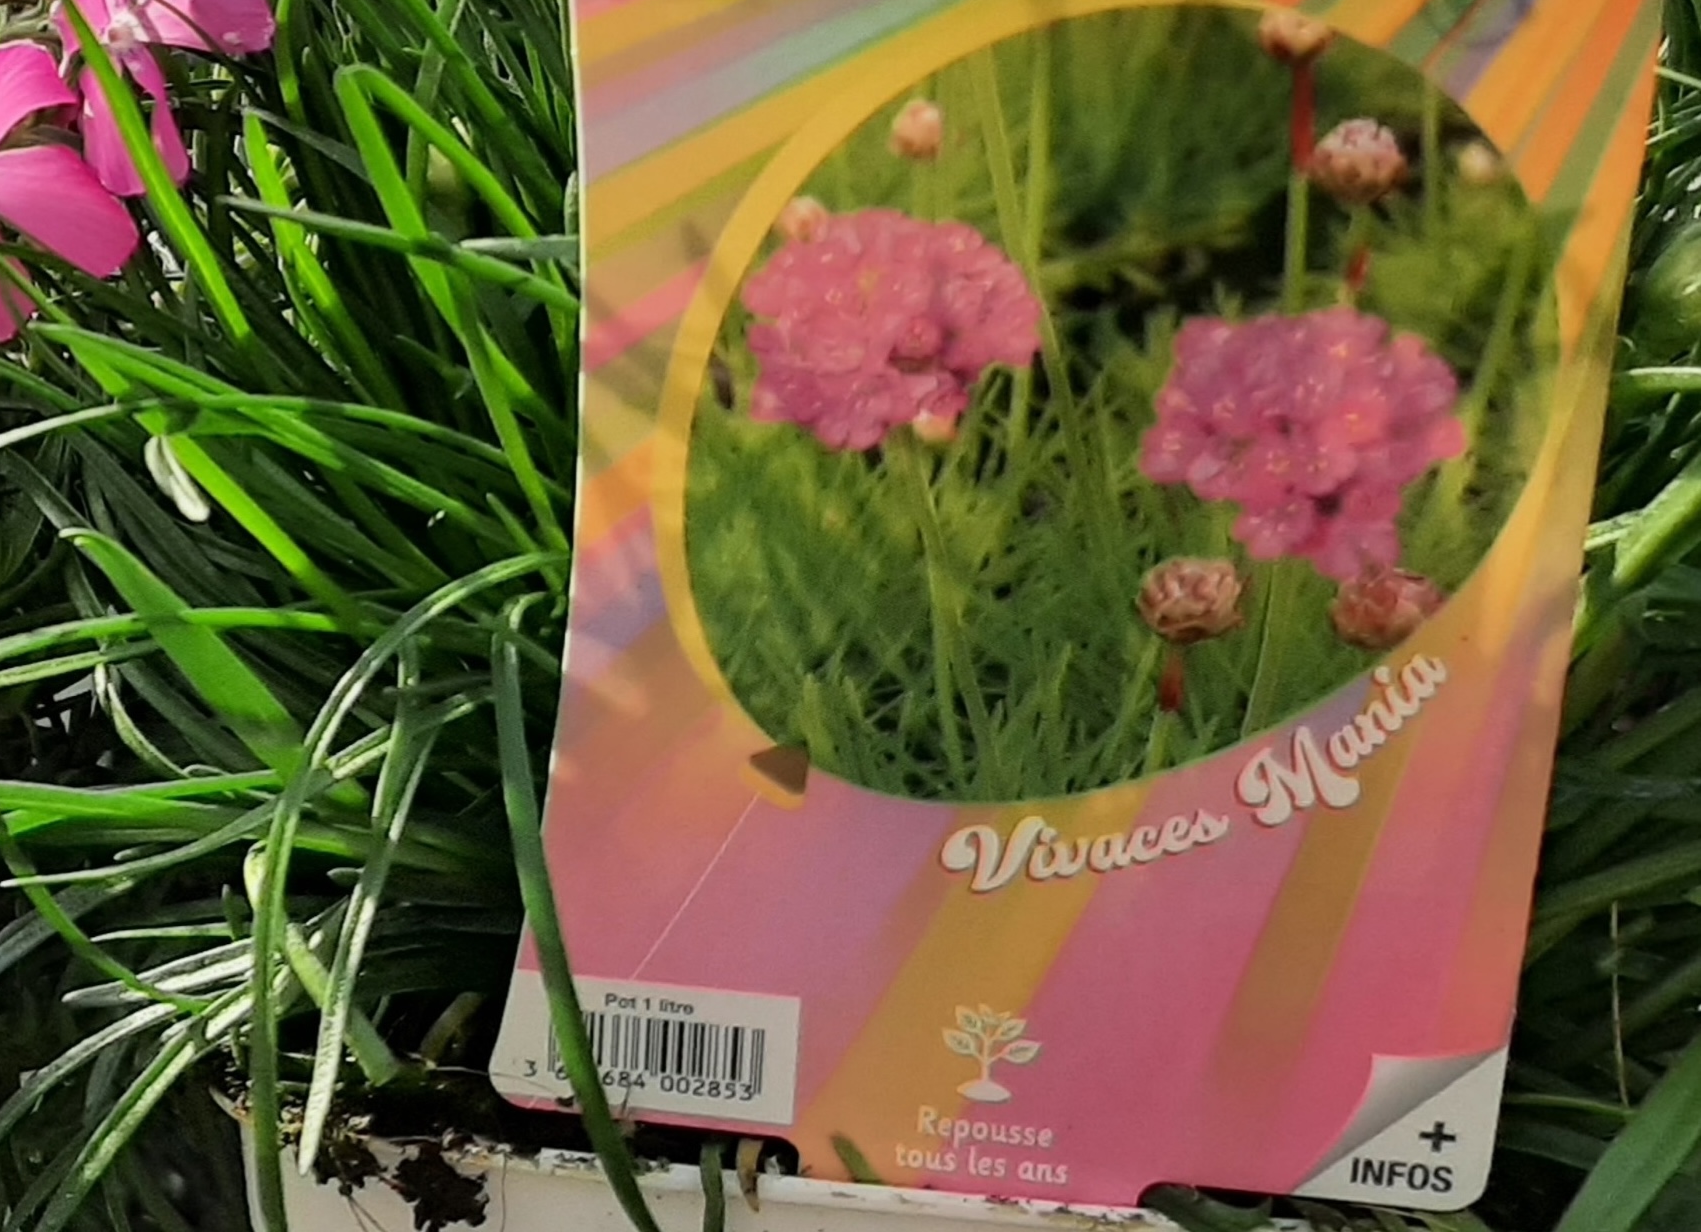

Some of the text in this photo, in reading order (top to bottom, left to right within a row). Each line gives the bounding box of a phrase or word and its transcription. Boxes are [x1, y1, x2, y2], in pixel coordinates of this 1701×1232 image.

[940, 654, 1447, 893] Vivaces Mania
[605, 993, 694, 1015] Pot 1 litre
[523, 1060, 538, 1078] 3
[659, 1075, 754, 1101] 002853
[917, 1105, 1054, 1149] Repousse
[896, 1143, 1069, 1185] tous les ans
[1349, 1157, 1454, 1193] INFOS
